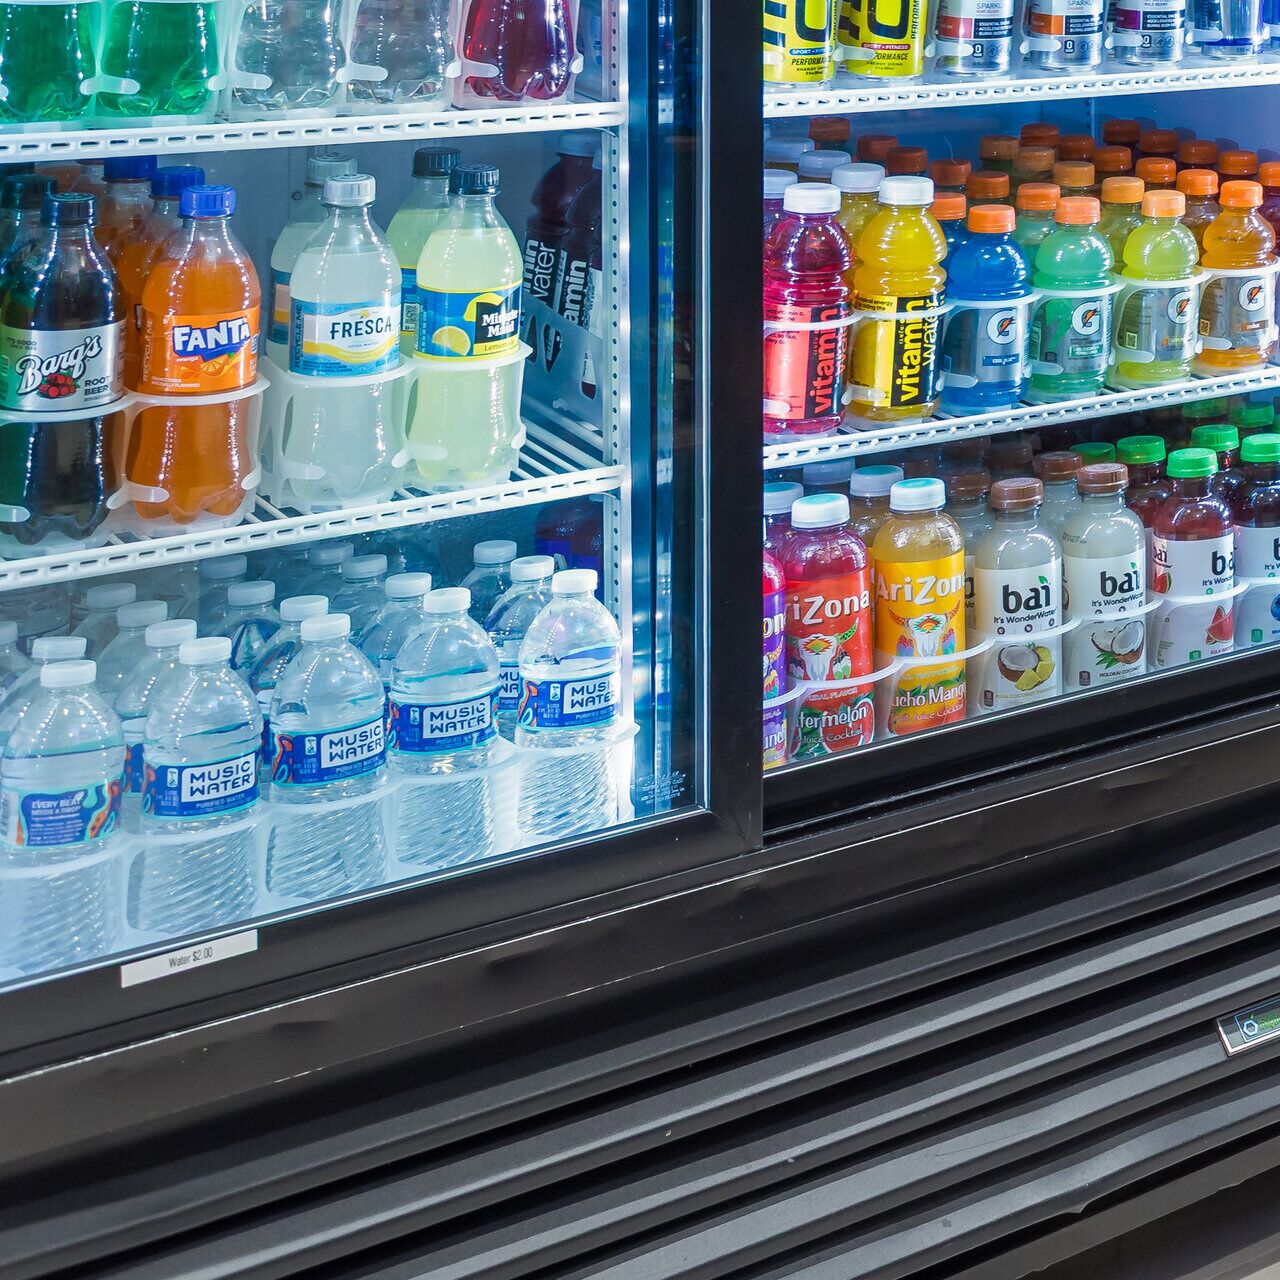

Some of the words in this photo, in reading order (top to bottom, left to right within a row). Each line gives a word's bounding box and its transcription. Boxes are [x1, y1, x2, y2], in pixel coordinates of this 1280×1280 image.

[330, 317, 393, 340] FRESCA
[487, 321, 515, 338] Maid
[896, 299, 925, 402] vitamin
[16, 335, 103, 396] Barq's
[84, 375, 111, 387] ROOT
[84, 386, 109, 396] BEER
[1002, 577, 1052, 614] bai
[429, 703, 486, 721] MUSIC
[329, 725, 382, 748] MUSIC
[429, 715, 486, 735] WATER
[329, 738, 383, 761] WATER
[189, 760, 251, 784] MUSIC
[189, 773, 252, 797] WATER
[169, 954, 191, 968] Water
[192, 946, 214, 962] $2.00
